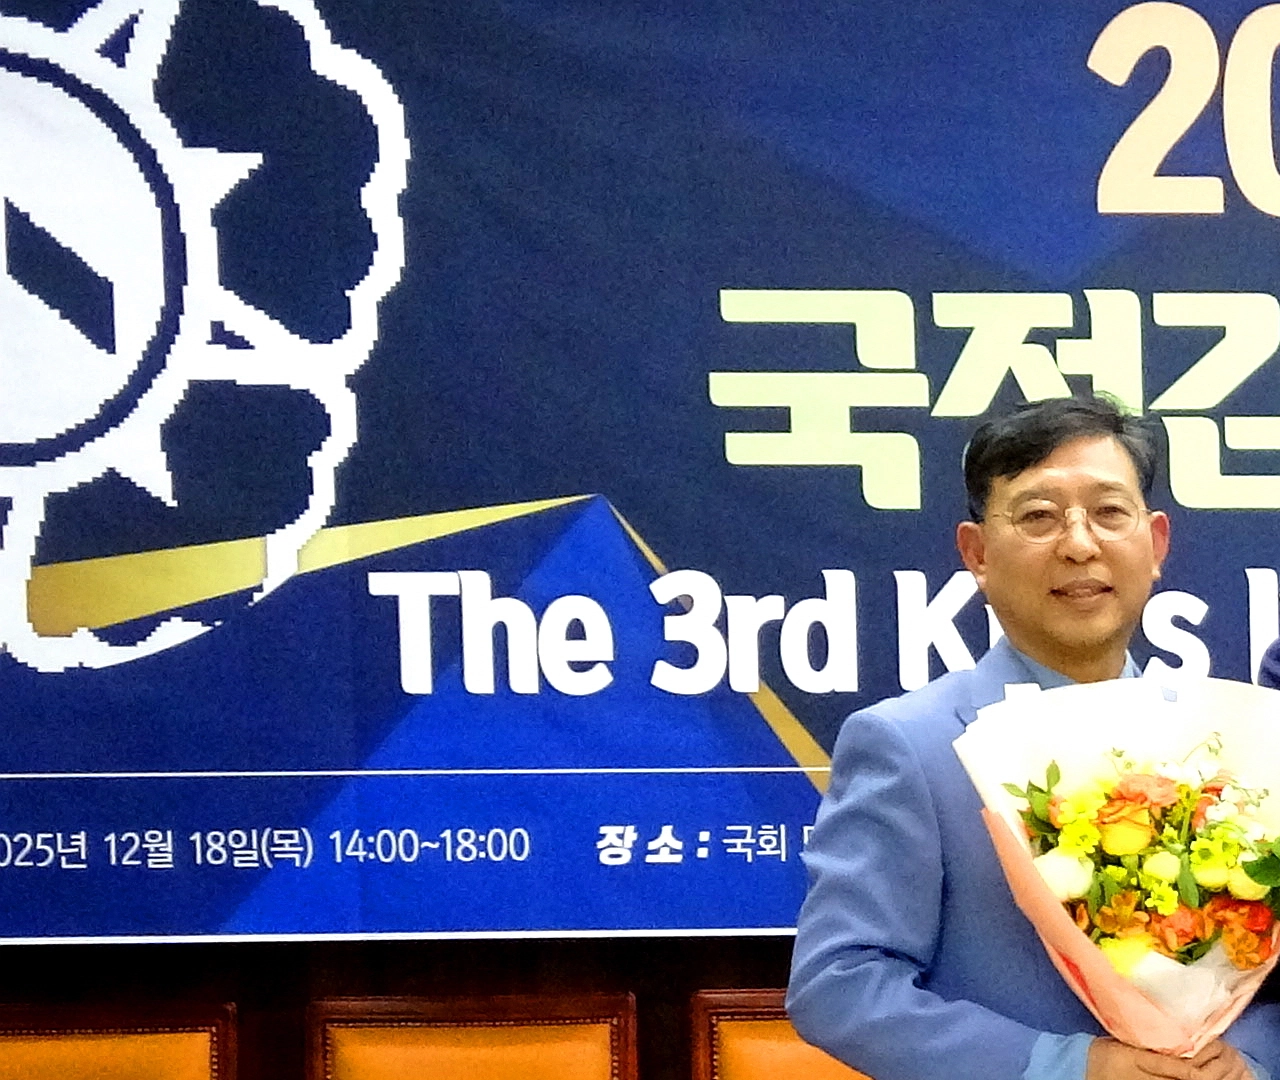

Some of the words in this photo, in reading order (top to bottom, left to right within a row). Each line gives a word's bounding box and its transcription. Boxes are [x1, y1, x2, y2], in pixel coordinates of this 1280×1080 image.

[367, 569, 615, 697] The
[650, 568, 858, 697] 3rd
[104, 829, 174, 869] 12월
[189, 827, 314, 869] 18일(목)
[329, 827, 531, 866] 14:00~18:00
[723, 824, 787, 862] 국회
